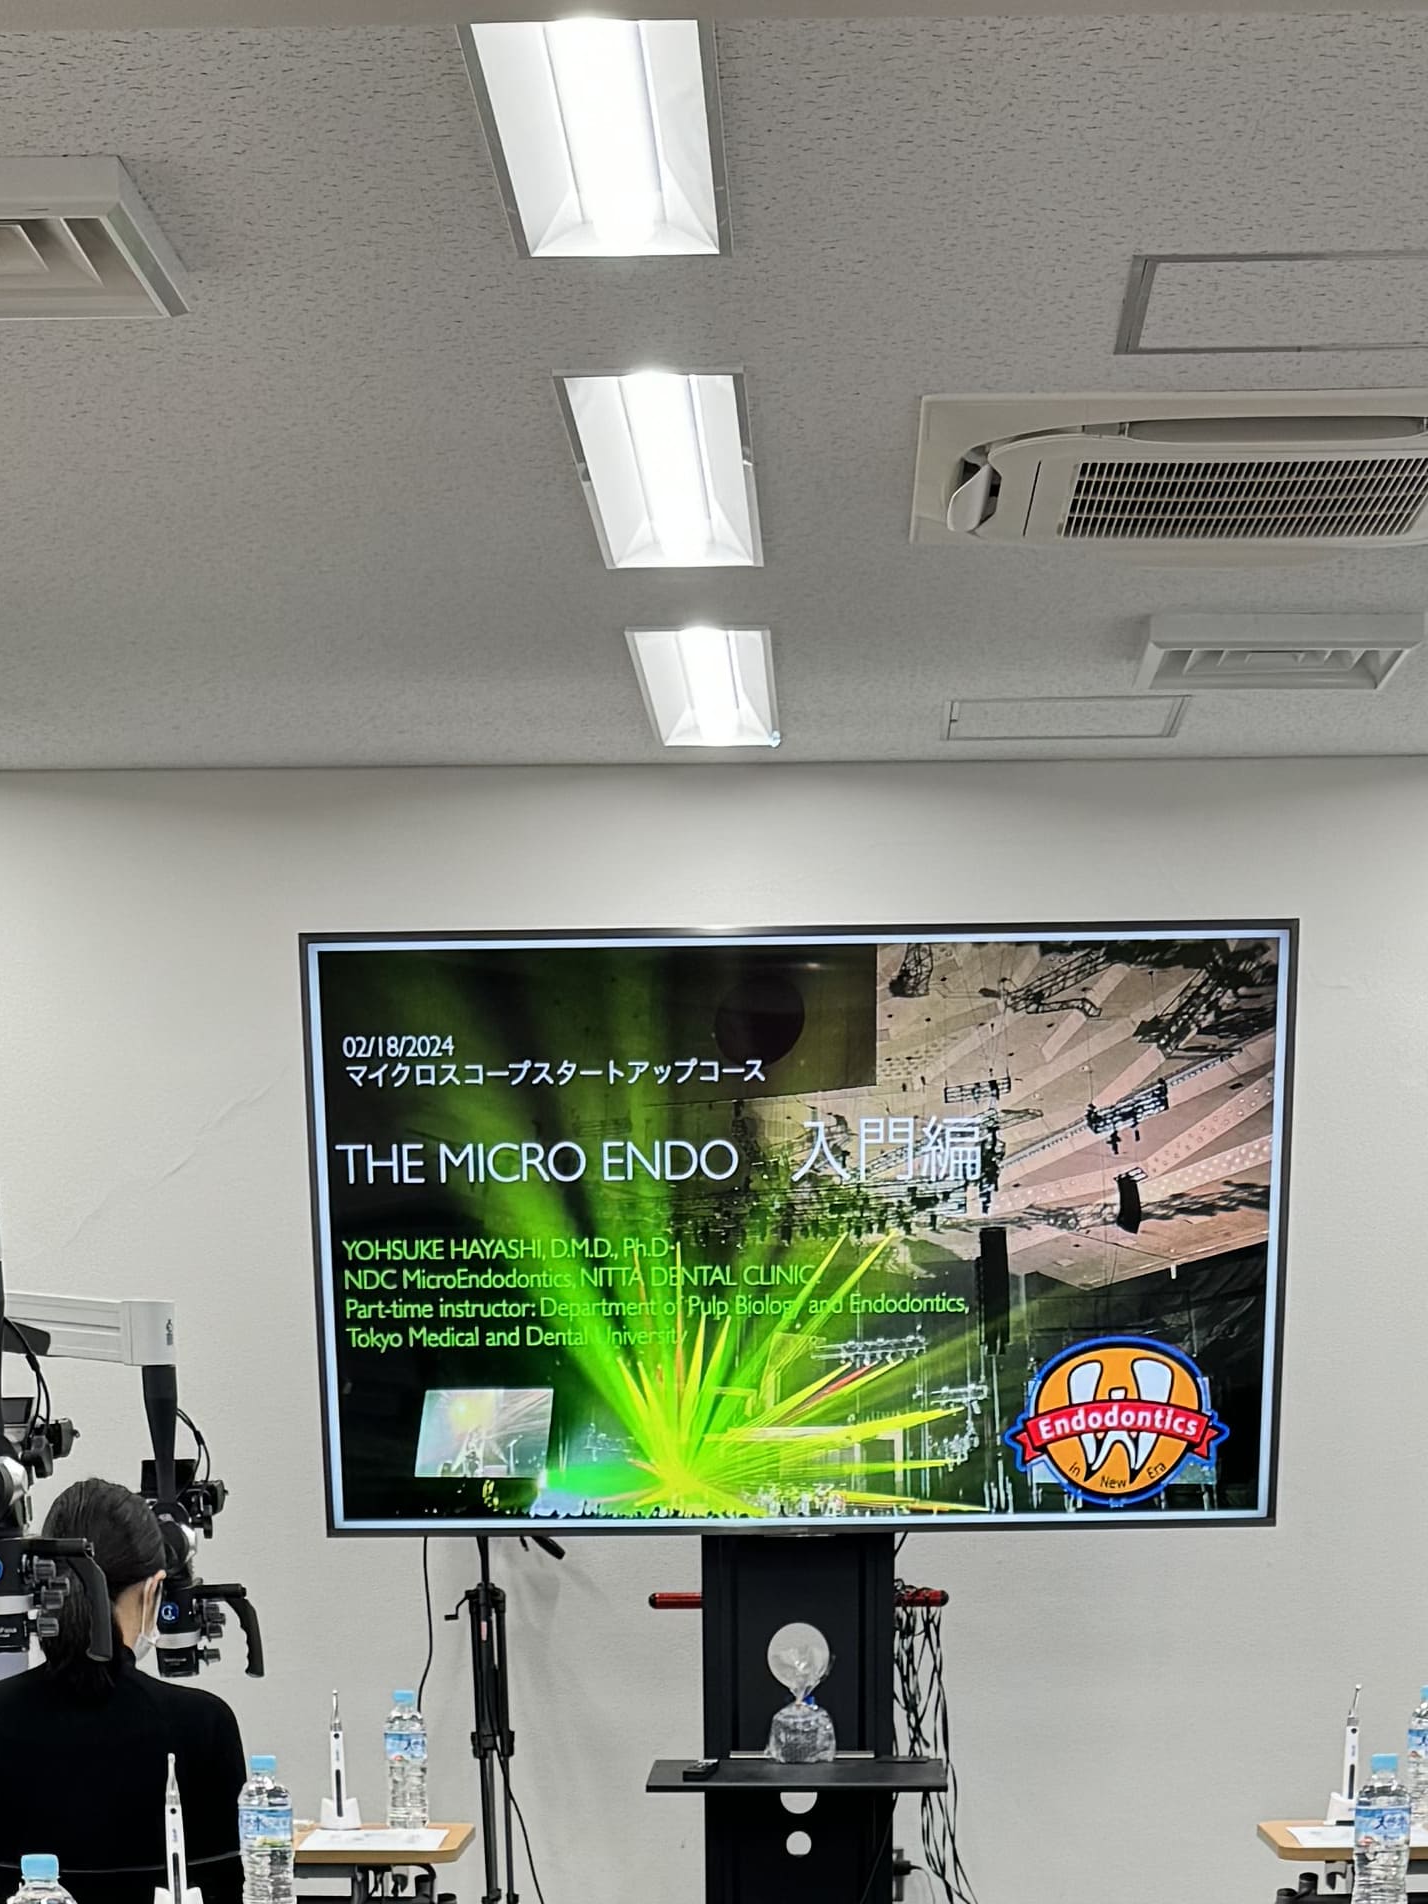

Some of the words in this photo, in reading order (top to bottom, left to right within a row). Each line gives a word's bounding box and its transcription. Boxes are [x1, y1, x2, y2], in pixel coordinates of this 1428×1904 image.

[342, 1035, 454, 1058] 02/18/2024
[345, 1058, 766, 1088] マイクロスコープスタートアップコース
[335, 1143, 426, 1184] THE
[440, 1141, 587, 1184] MICRO
[602, 1139, 739, 1183] ENDO
[791, 1115, 982, 1183] 入門編
[342, 1239, 445, 1261] YOHSUKE
[450, 1239, 547, 1262] HAYASHI,
[551, 1238, 619, 1261] D.M.D.,
[344, 1269, 397, 1290] NDC
[403, 1268, 576, 1290] MicroEndodontics,
[581, 1266, 645, 1288] NITTA
[651, 1265, 738, 1287] DENTAL
[345, 1298, 434, 1319] Part-time
[439, 1297, 536, 1319] instructor:
[540, 1296, 657, 1322] Department
[688, 1294, 729, 1320] Pulp
[735, 1293, 805, 1320] Biolog
[808, 1294, 843, 1314] and
[850, 1292, 970, 1315] Endodontics,
[345, 1327, 402, 1353] Tokyo
[409, 1326, 479, 1348] Medical
[486, 1326, 520, 1347] and
[526, 1325, 588, 1347] Dental
[1038, 1404, 1199, 1440] Endodontics
[1100, 1475, 1127, 1489] New
[1146, 1462, 1168, 1480] Era
